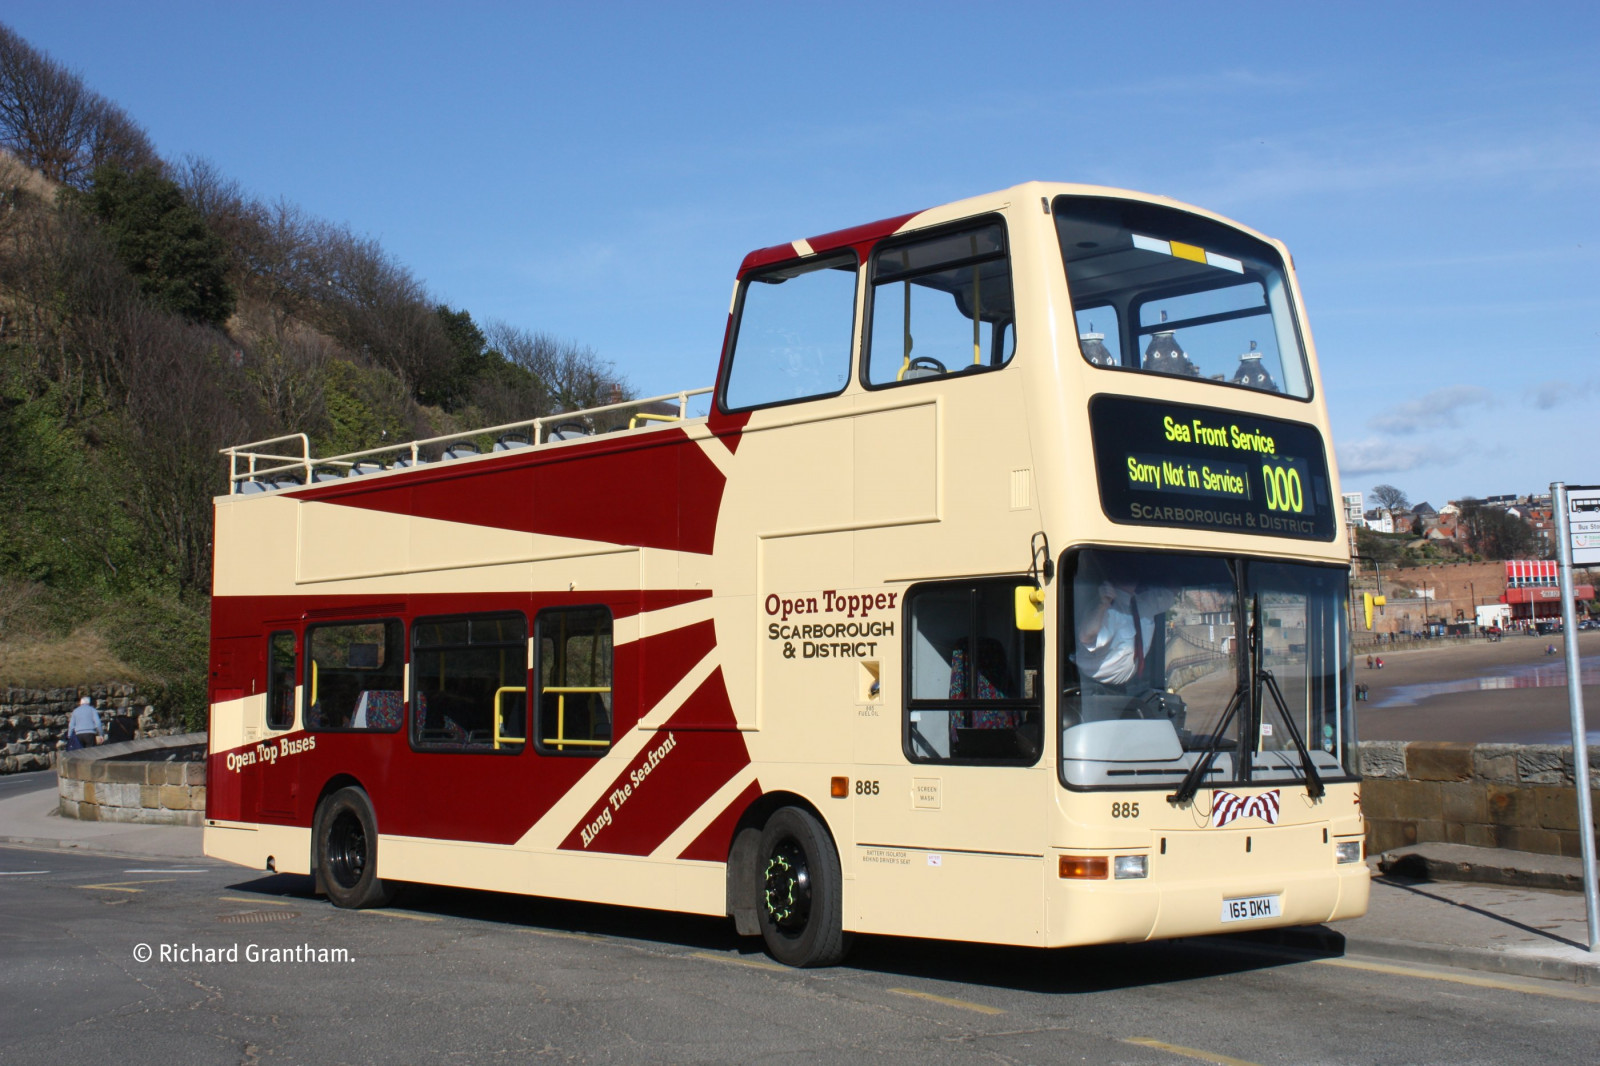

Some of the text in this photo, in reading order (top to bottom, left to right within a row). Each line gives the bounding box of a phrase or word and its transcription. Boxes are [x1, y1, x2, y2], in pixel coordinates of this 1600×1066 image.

[1164, 416, 1275, 454] Sea Front Service
[1127, 456, 1244, 494] Sorry Not in Service
[1130, 502, 1315, 534] SCARBOROUGH & DISTRICT
[765, 590, 897, 621] Open Topper
[768, 621, 894, 640] SCARBOROUGH
[783, 641, 877, 659] & DISTRICT
[227, 736, 315, 773] Open Top Buses
[580, 731, 677, 848] Along The Seafront
[855, 780, 880, 795] 885
[1111, 802, 1139, 818] 885
[1229, 899, 1271, 918] 165 DKH
